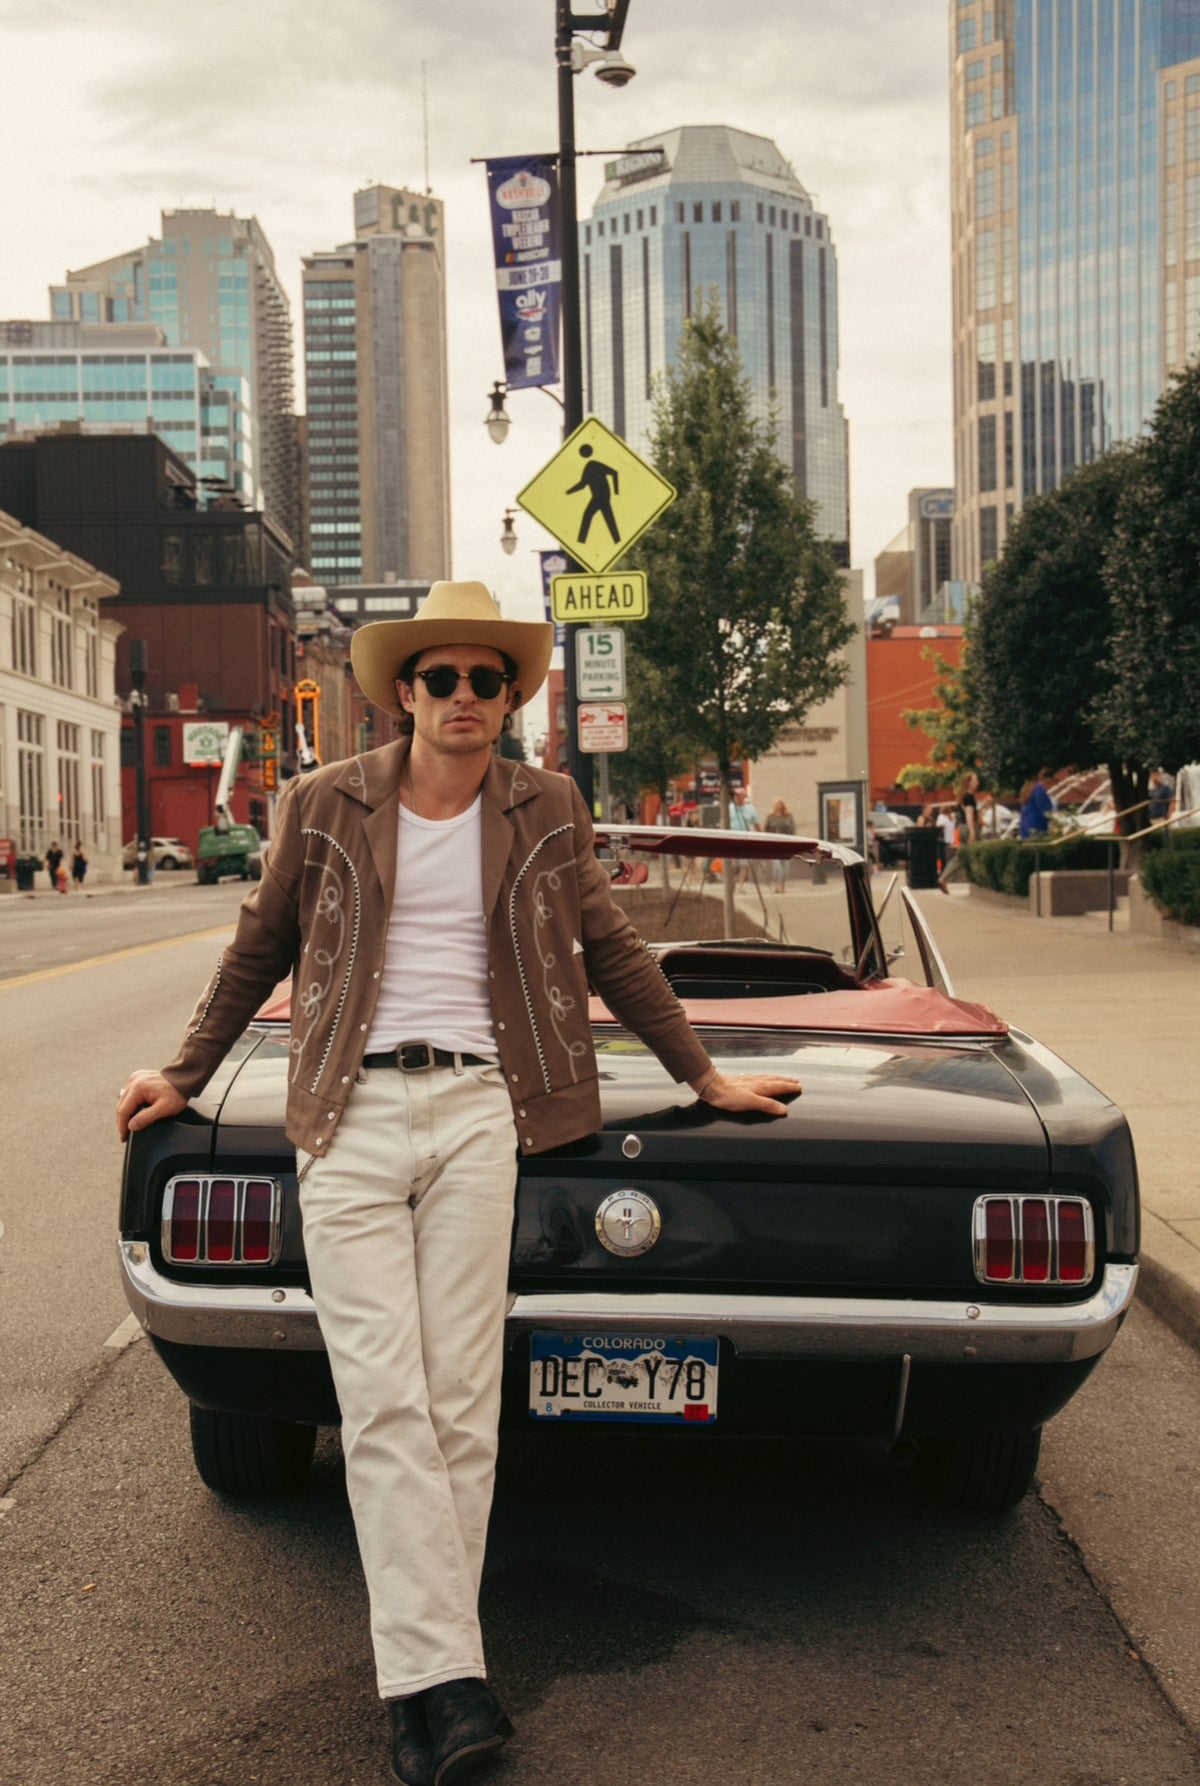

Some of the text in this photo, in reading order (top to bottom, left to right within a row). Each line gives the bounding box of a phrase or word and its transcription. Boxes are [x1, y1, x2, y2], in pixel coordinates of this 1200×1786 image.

[502, 187, 545, 202] NASHVILLE
[515, 289, 546, 309] ally
[565, 583, 634, 610] AHEAD
[587, 634, 613, 655] 15
[584, 658, 616, 669] MINUTE
[582, 671, 620, 682] PARKING
[607, 1191, 650, 1204] FORD
[582, 1336, 666, 1350] COLORADO
[540, 1356, 706, 1400] DEC Y78
[545, 1401, 553, 1413] 8
[583, 1400, 661, 1410] COLLECTOR VEHICLE
